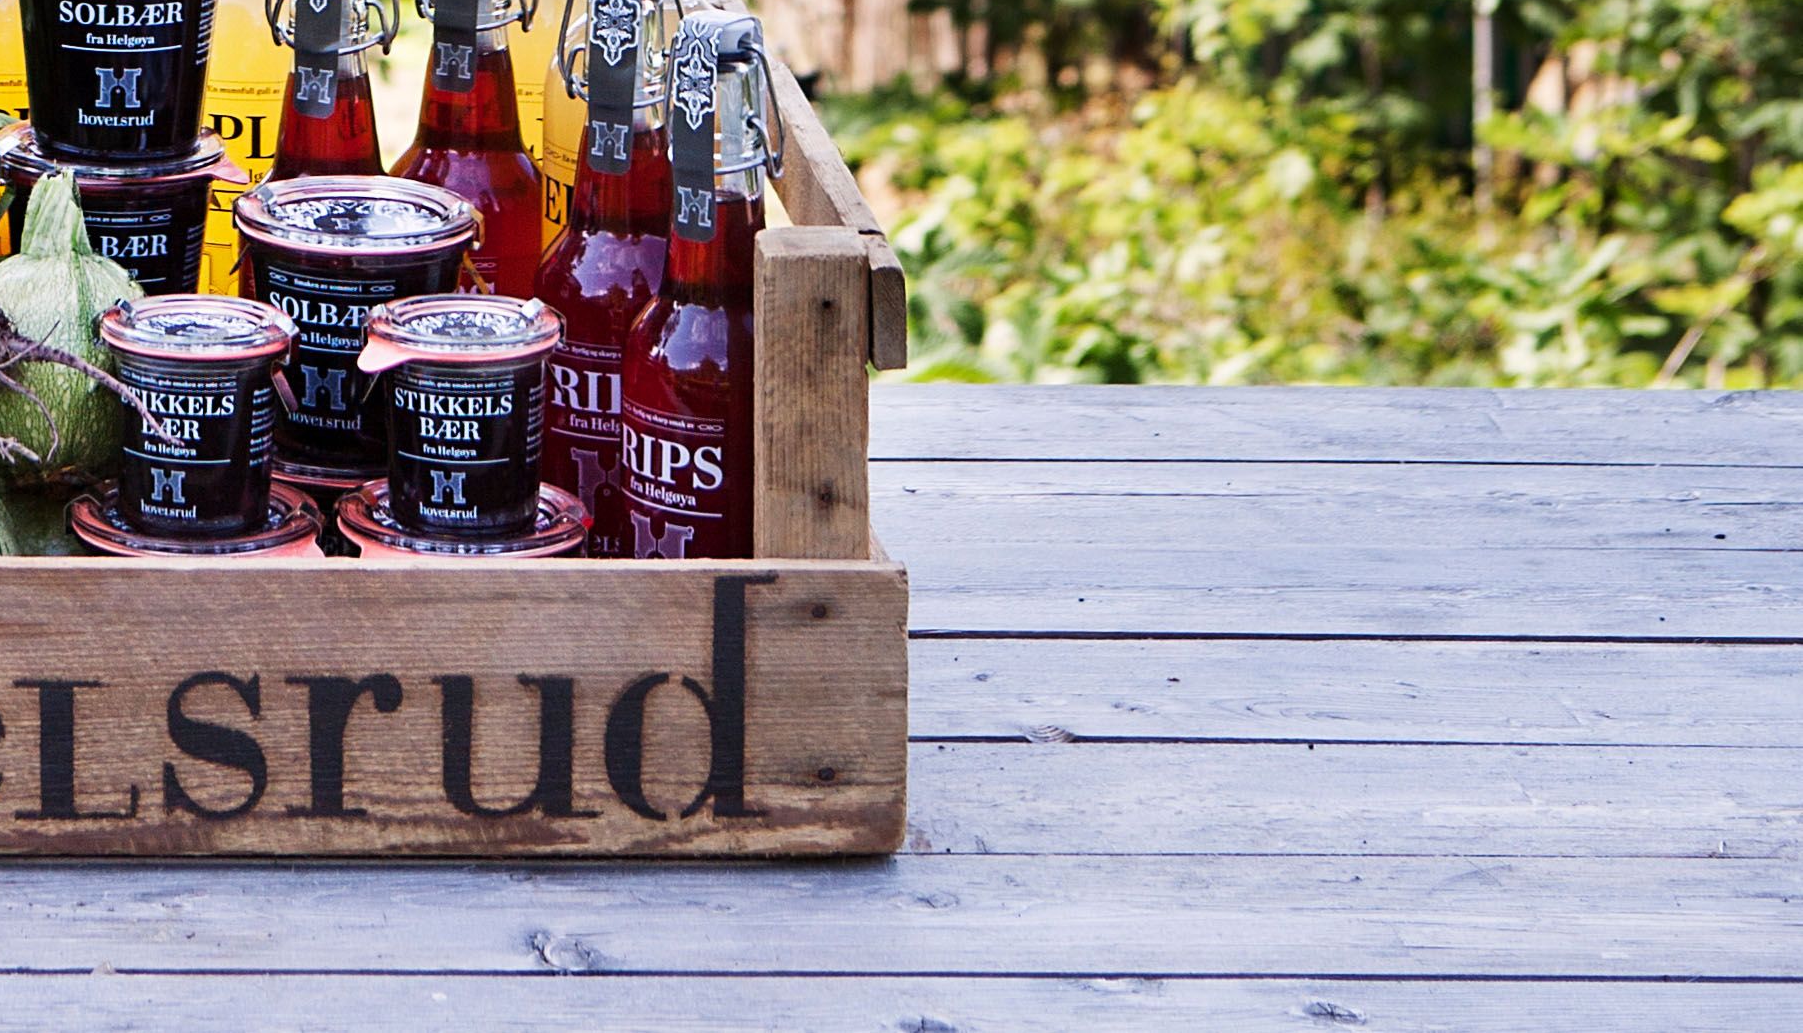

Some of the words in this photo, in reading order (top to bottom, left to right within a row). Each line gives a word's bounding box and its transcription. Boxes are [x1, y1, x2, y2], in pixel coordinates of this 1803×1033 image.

[59, 0, 183, 27] SOLBÆR
[86, 32, 104, 45] fra
[106, 34, 155, 48] Helgøya
[99, 234, 168, 258] BÆR
[269, 291, 370, 328] SOLBÆ
[310, 332, 360, 349] Helgøya
[394, 387, 513, 416] STIKKELS
[420, 416, 481, 441] BÆR
[569, 414, 589, 430] fra
[144, 441, 157, 452] fra
[423, 443, 436, 455] fra
[438, 445, 477, 458] Helgøya
[622, 422, 724, 491] RIPS
[630, 475, 644, 491] fra
[645, 483, 697, 508] Helgøya
